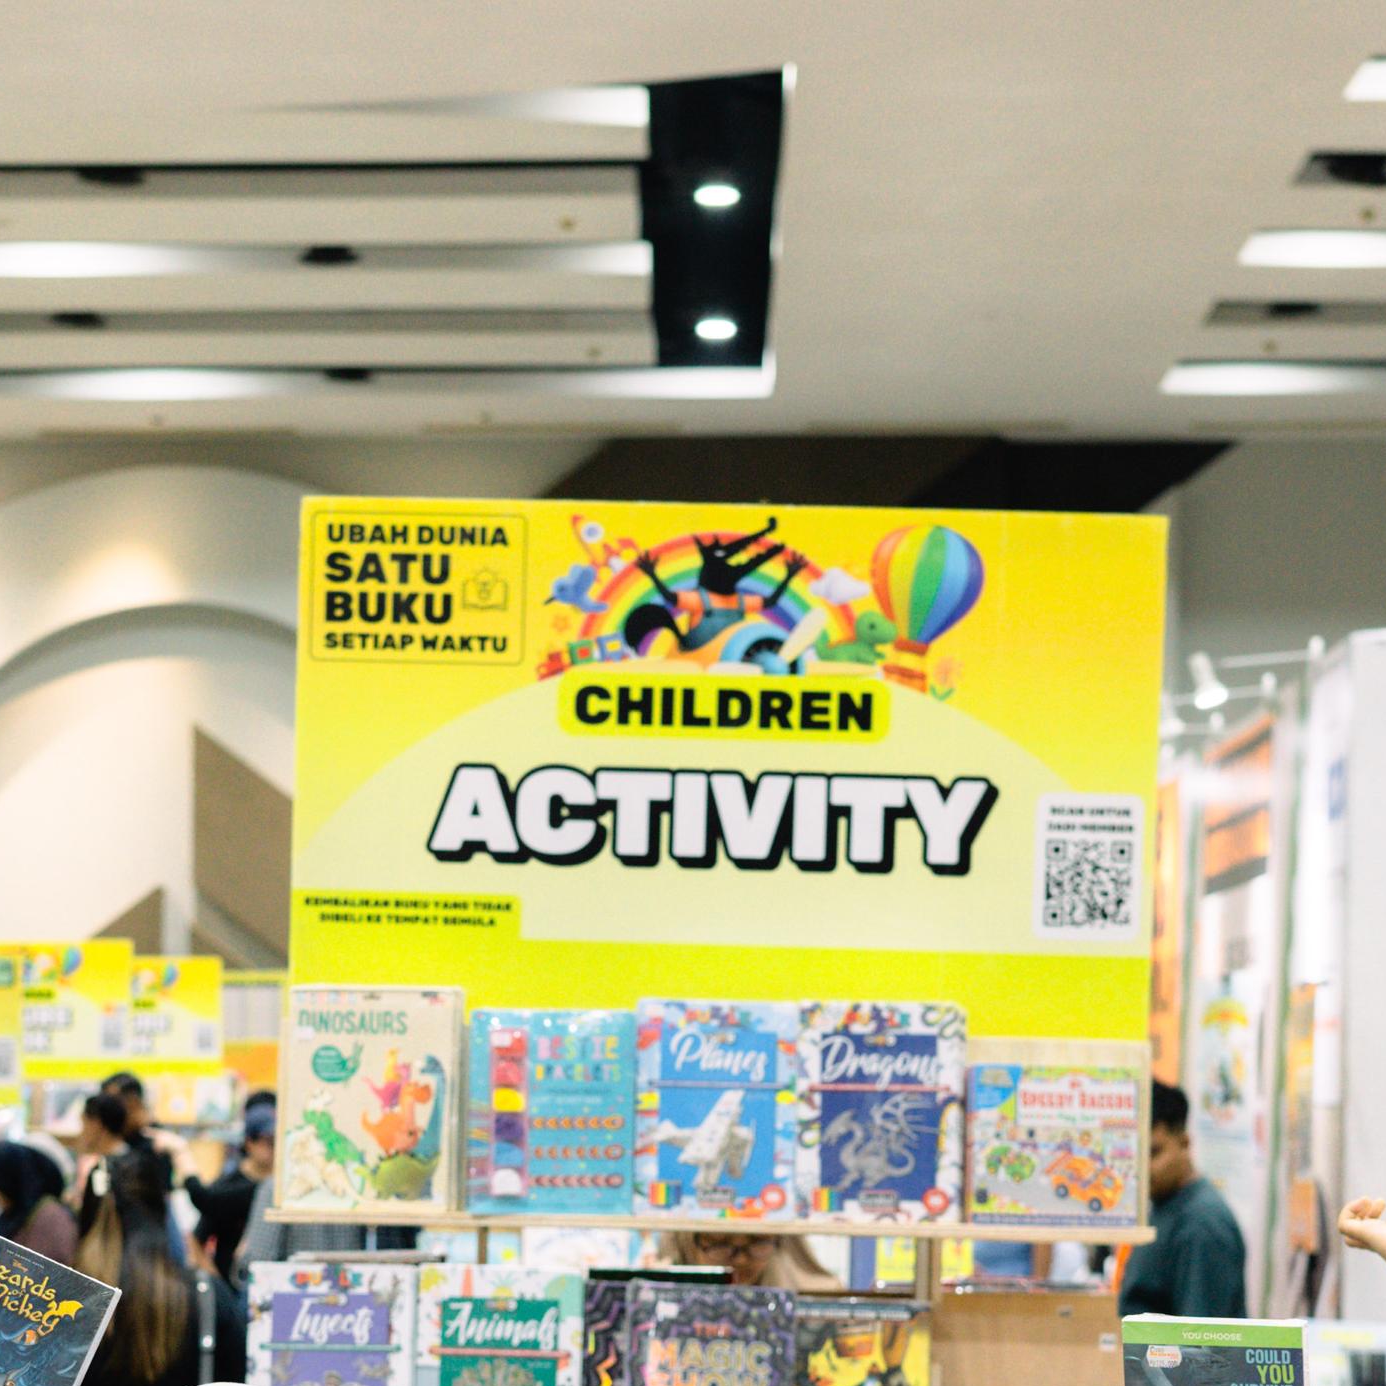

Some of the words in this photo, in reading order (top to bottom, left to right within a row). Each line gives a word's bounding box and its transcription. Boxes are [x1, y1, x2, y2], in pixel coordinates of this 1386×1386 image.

[327, 523, 409, 545] UBAH
[417, 525, 509, 547] DUNIA
[324, 551, 451, 585] SATU
[324, 590, 453, 625] BUKU
[324, 631, 414, 651] SETIAP
[421, 634, 508, 653] WAKTU
[574, 684, 874, 733] CHILDREN
[427, 762, 999, 876] ACTIVITY
[669, 1030, 769, 1083] Planes
[818, 1034, 941, 1089] Dragons
[289, 1298, 375, 1345] Insects
[445, 1301, 559, 1352] Animals
[693, 1321, 732, 1338] THE
[1182, 1332, 1202, 1341] YOU
[1203, 1332, 1243, 1342] CHOOSE
[648, 1338, 773, 1376] MAGIC
[1245, 1349, 1291, 1365] COULD
[1256, 1364, 1295, 1385] YOU
